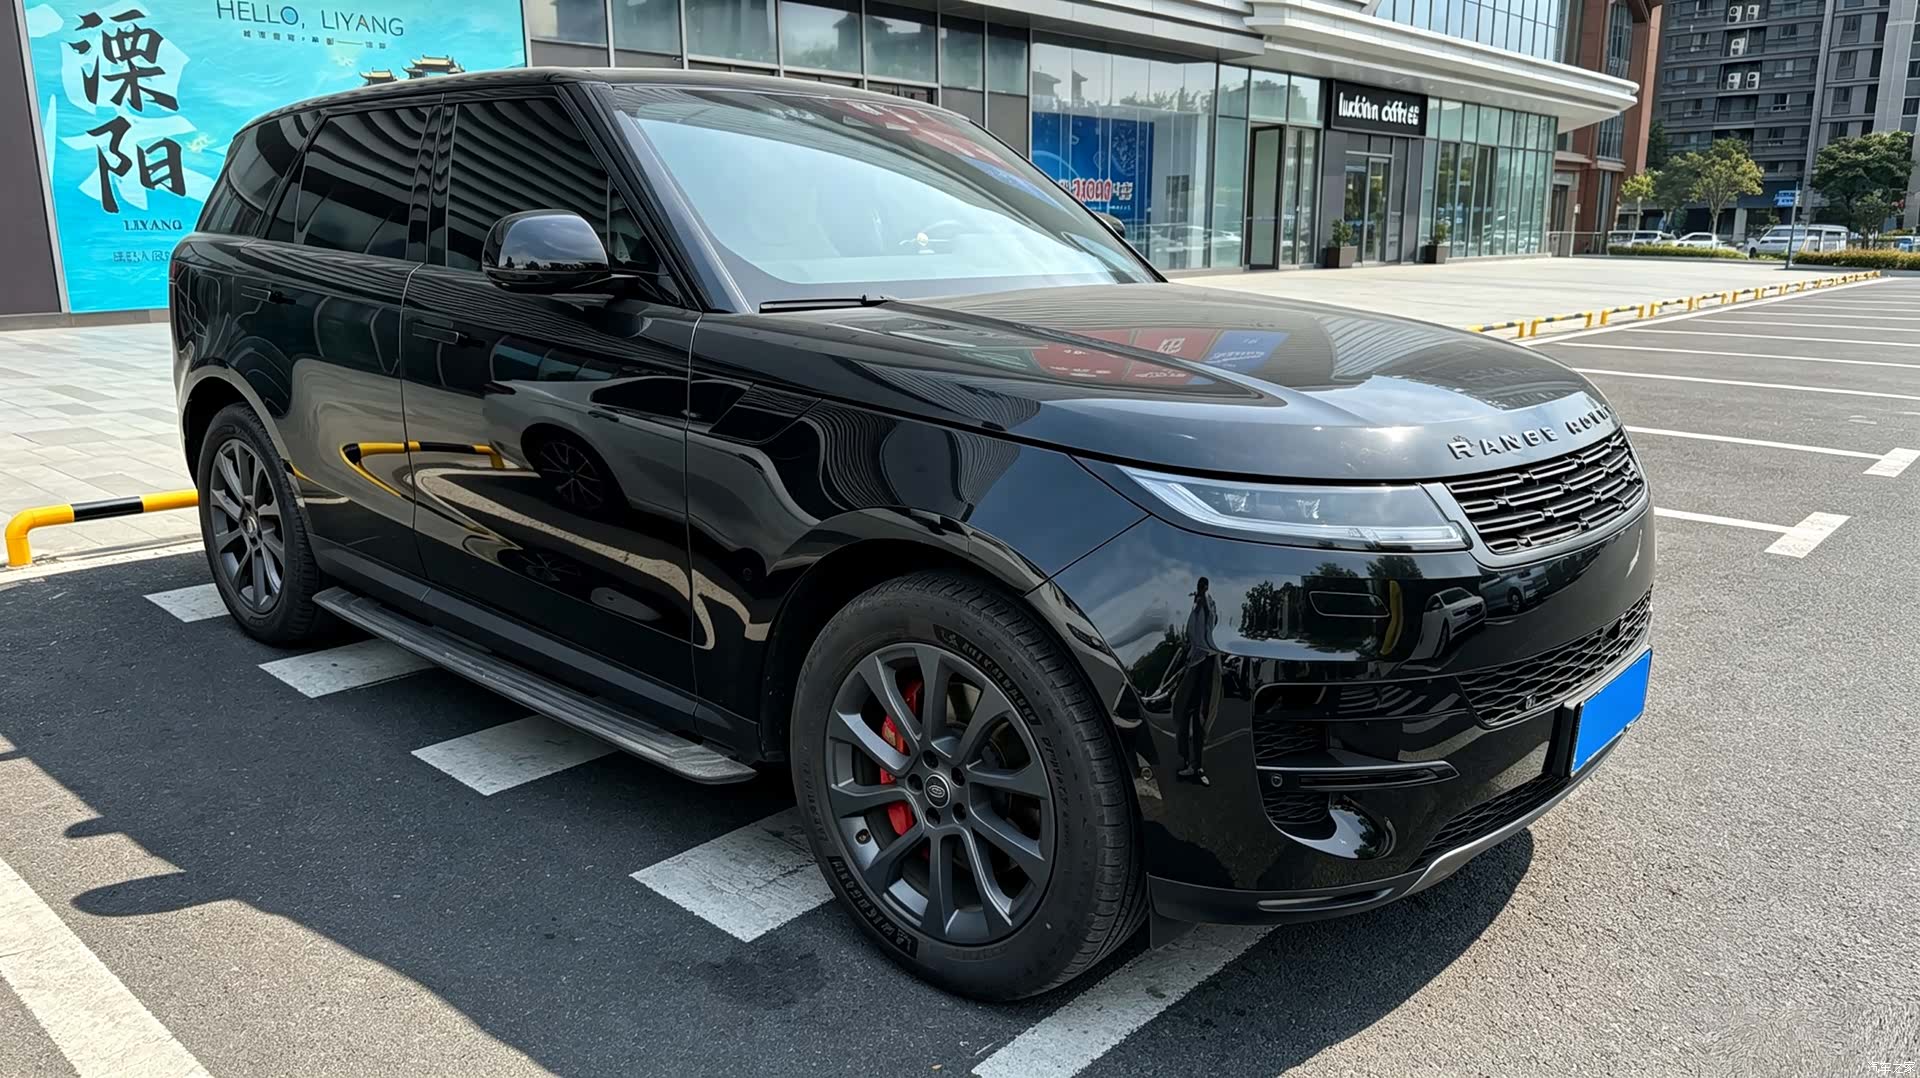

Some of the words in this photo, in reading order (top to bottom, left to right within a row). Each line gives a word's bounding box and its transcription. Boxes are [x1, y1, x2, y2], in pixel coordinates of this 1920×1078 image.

[216, 0, 306, 29] HELLO,
[321, 9, 404, 37] LIYANG
[68, 9, 187, 214] 溧阳
[1447, 426, 1559, 460] RANGE
[1564, 404, 1611, 436] ROV
